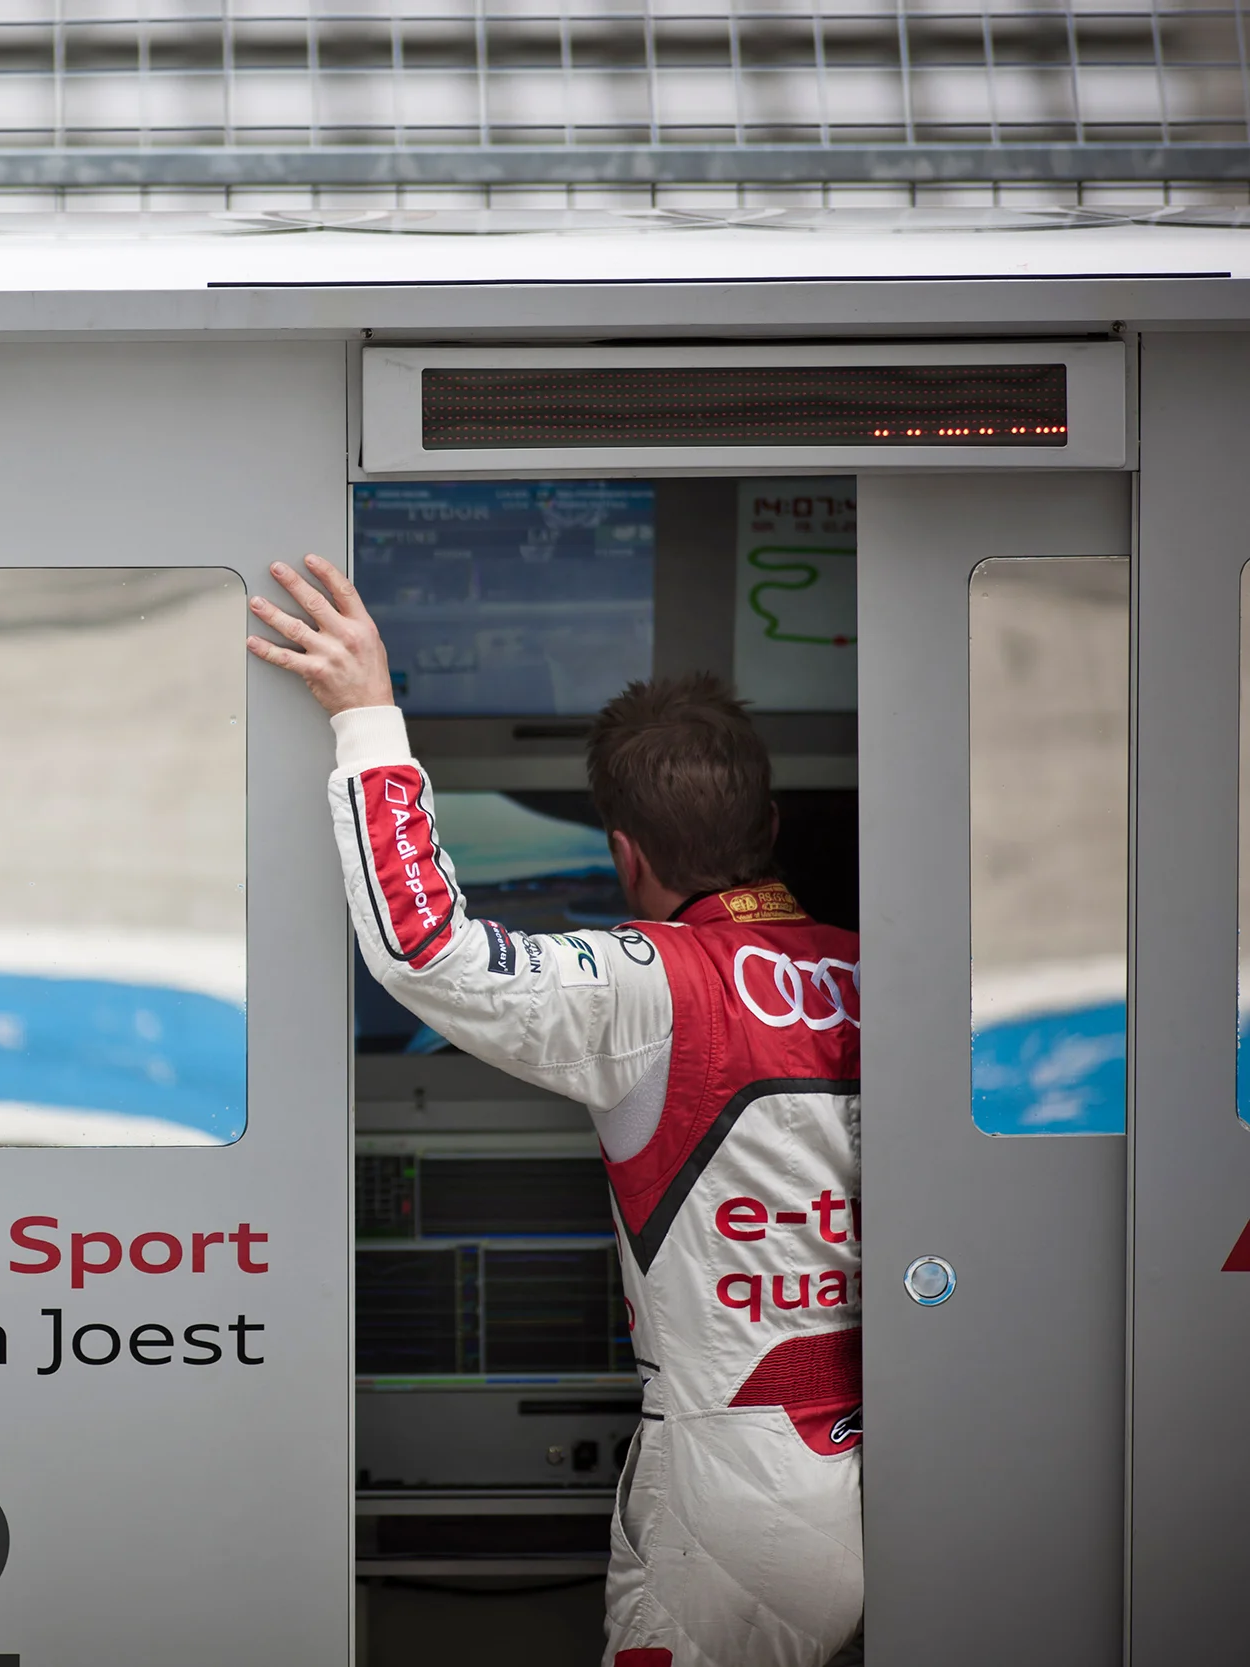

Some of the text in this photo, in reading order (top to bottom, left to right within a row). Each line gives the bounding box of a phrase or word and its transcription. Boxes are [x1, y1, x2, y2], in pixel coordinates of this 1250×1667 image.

[391, 808, 442, 930] Audi Sport
[9, 1216, 269, 1289] Sport
[37, 1308, 265, 1375] Joest
